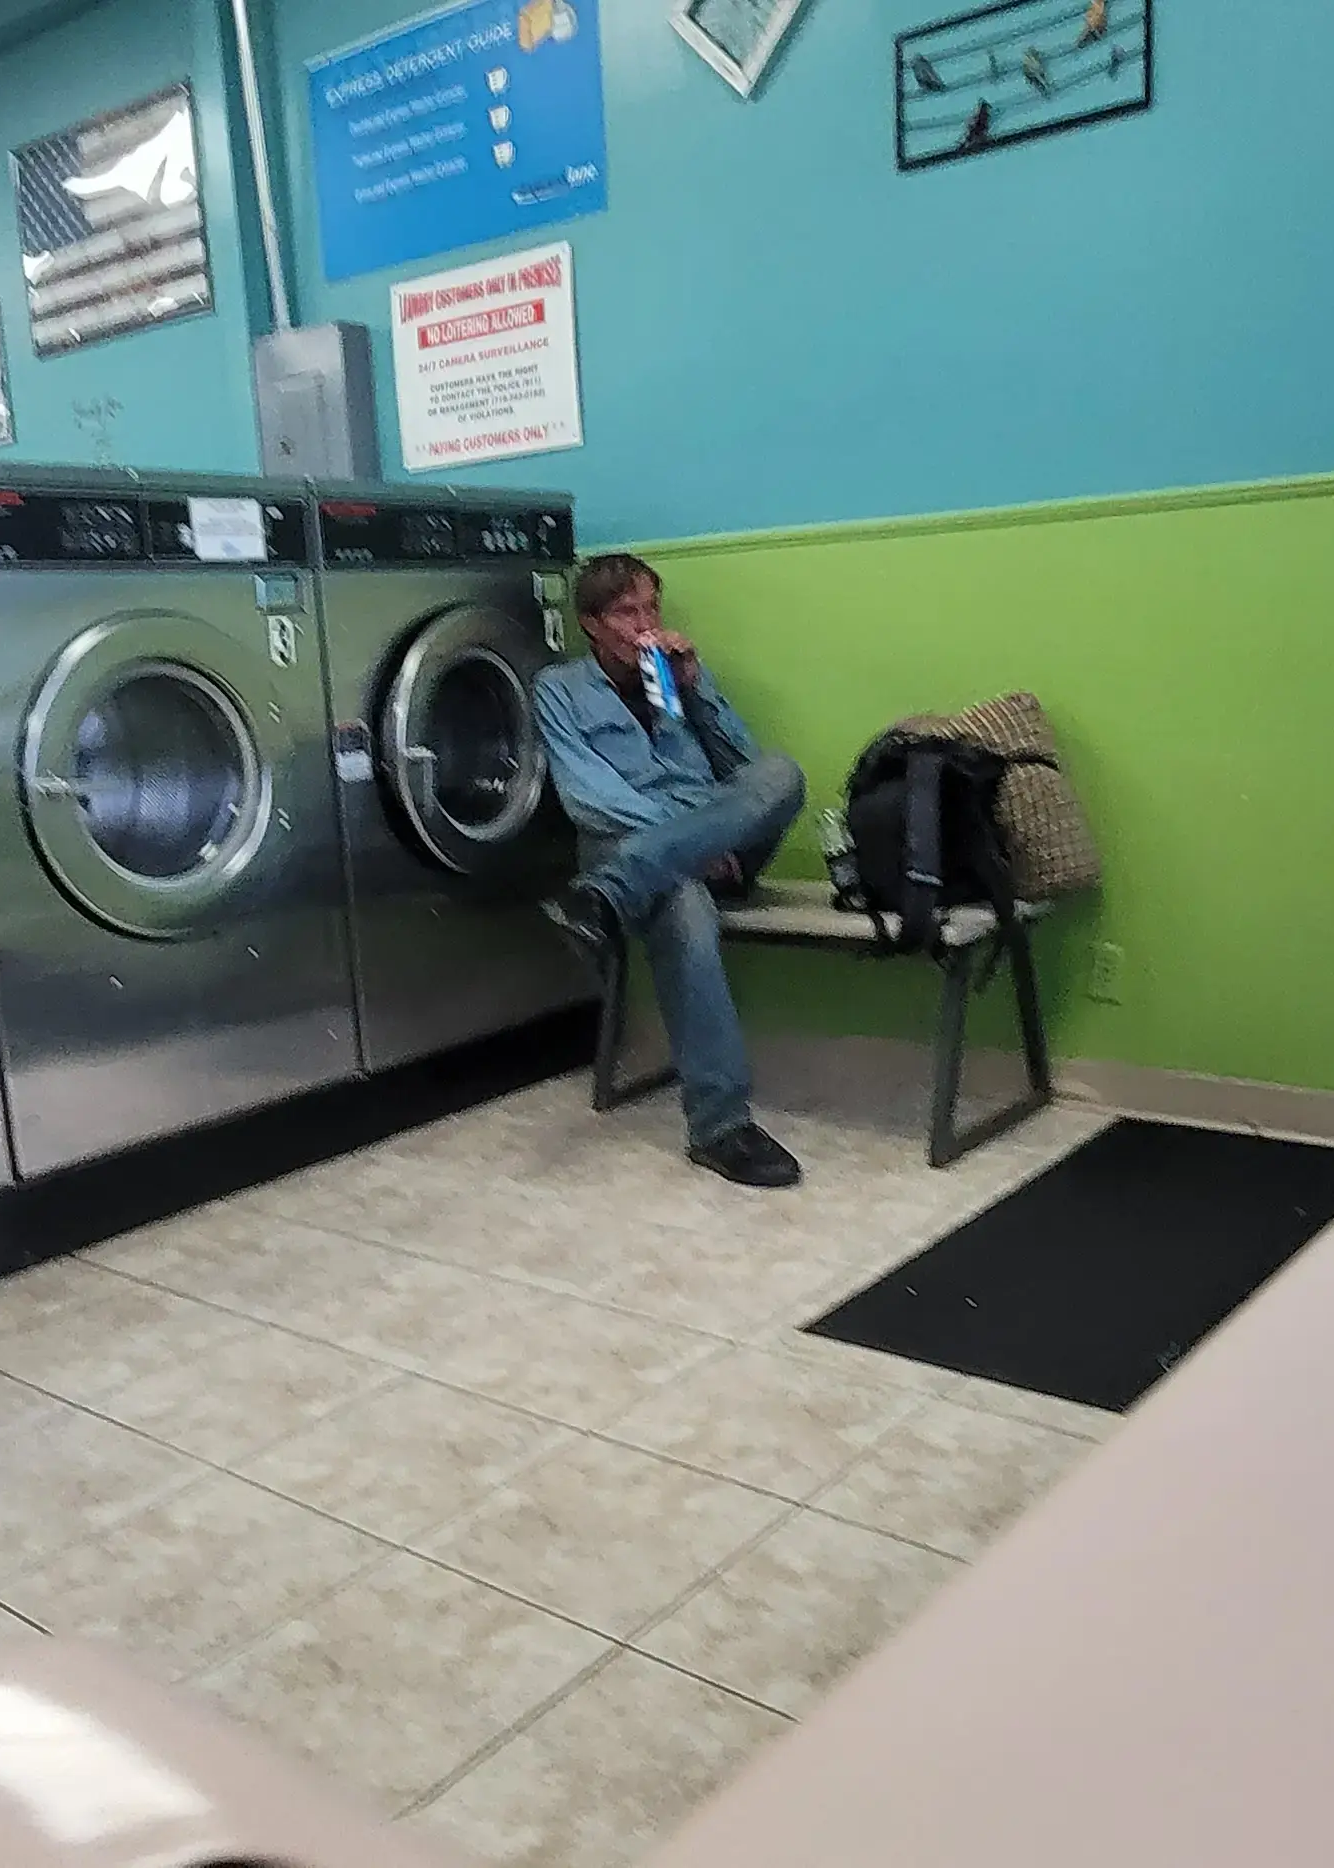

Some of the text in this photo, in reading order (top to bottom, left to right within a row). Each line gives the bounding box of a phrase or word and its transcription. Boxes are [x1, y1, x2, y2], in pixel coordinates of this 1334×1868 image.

[385, 42, 465, 85] DETERGENT
[466, 21, 514, 53] GUIDE
[434, 279, 485, 310] CUSTOMERS
[485, 274, 506, 296] ONLY
[426, 304, 535, 345] NO LOITERING ALLOWED
[418, 337, 549, 374] 24/7 CAMERA SURVEILLANCE
[430, 376, 474, 393] CUSTOMERS
[475, 371, 496, 383] HAVE
[497, 368, 513, 379] THE
[441, 389, 475, 403] CONTACT
[493, 381, 520, 393] POLICE
[439, 398, 489, 414] MANAGEMENT
[428, 422, 549, 456] PAYING CUSTOMERS ONLY
